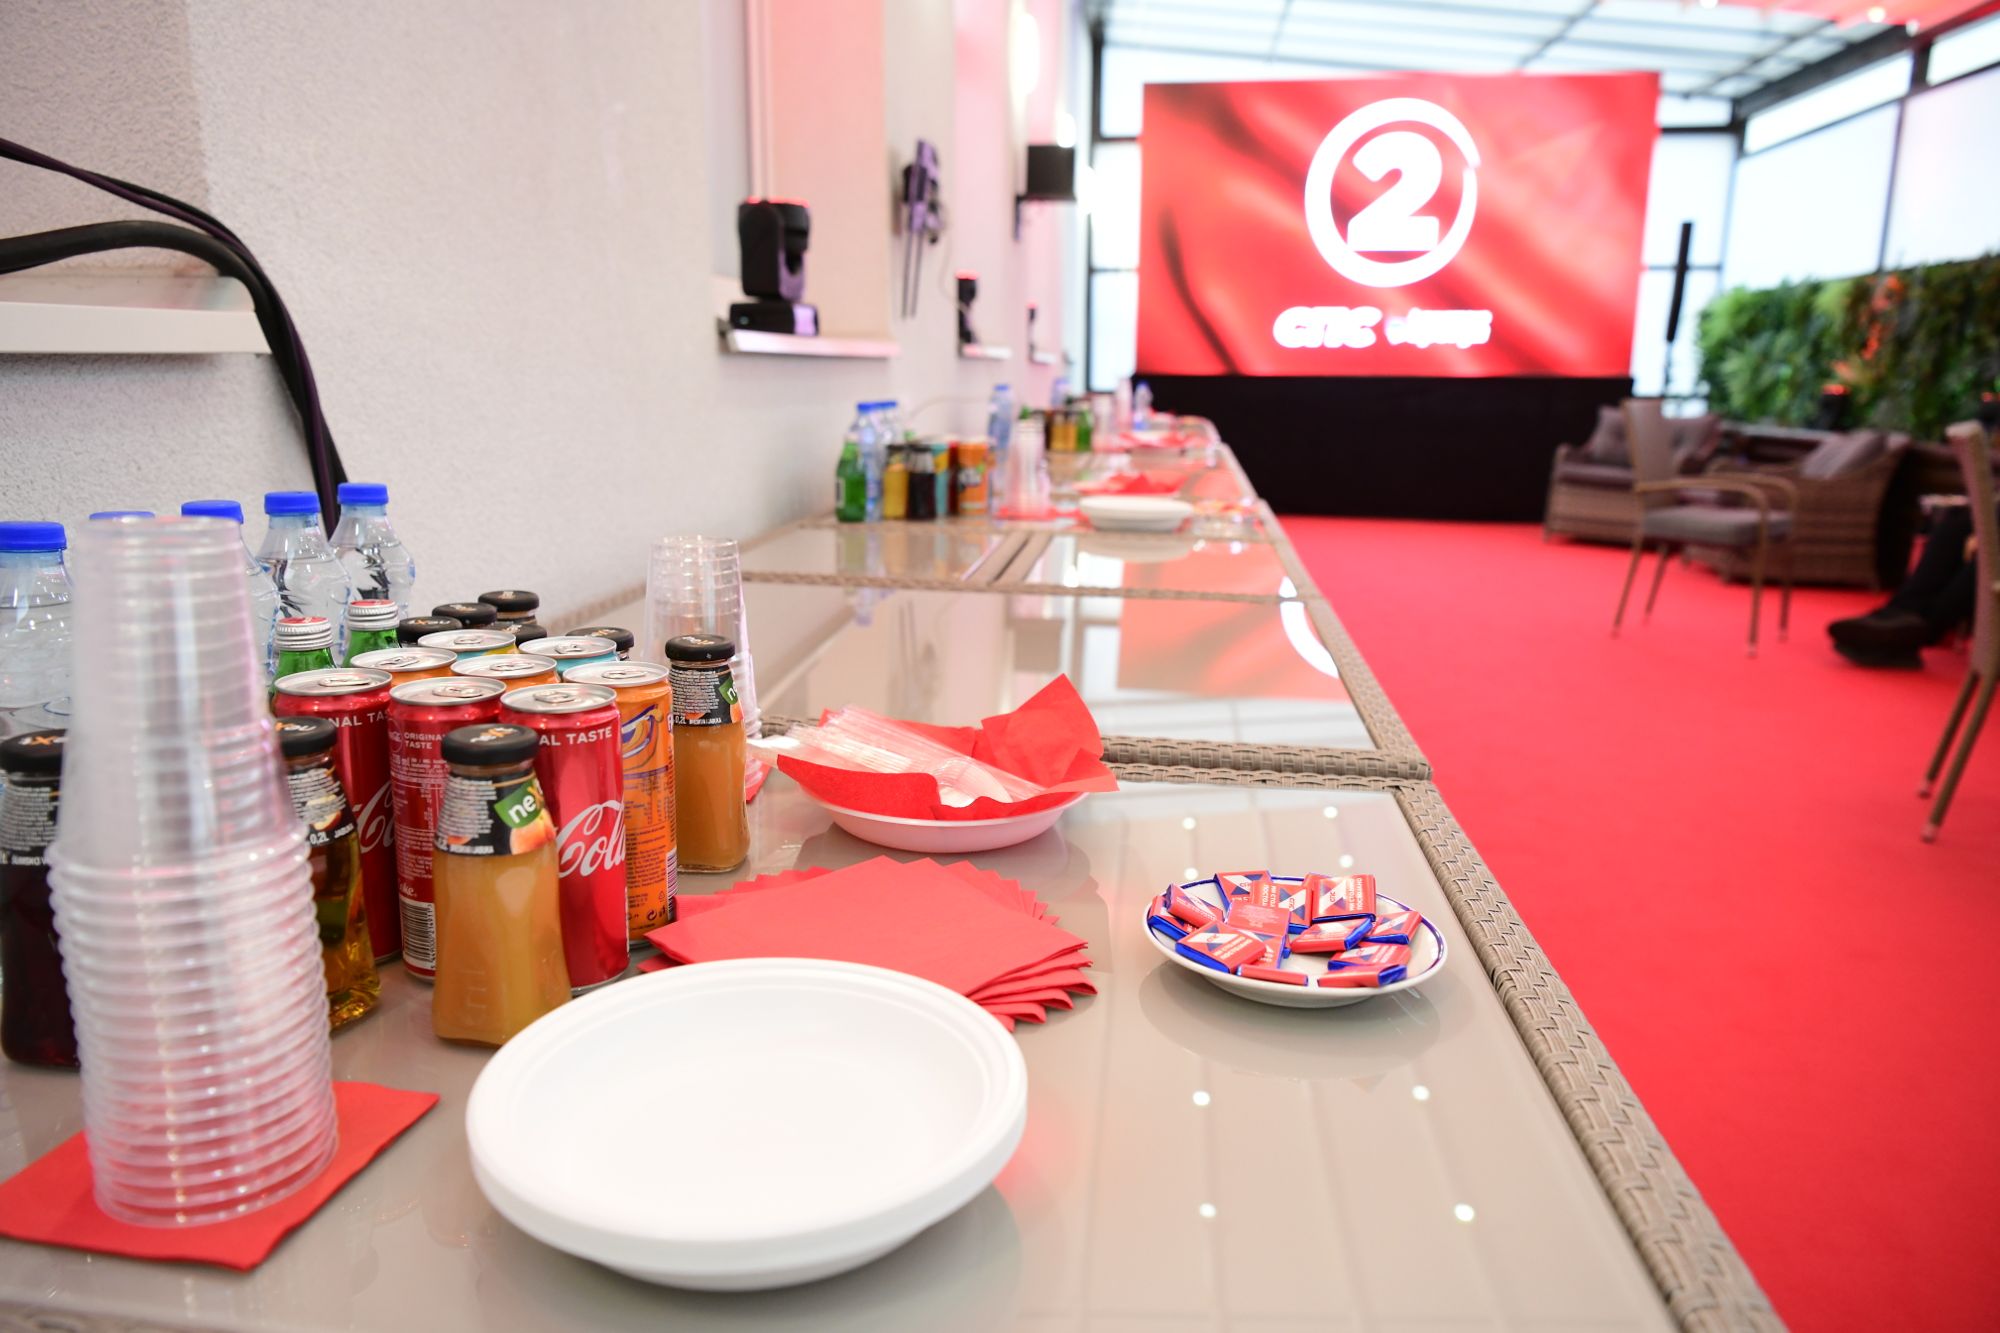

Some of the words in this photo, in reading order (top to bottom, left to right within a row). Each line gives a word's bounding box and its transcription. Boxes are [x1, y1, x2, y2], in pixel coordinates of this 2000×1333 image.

[1347, 130, 1443, 252] 2
[403, 732, 446, 741] ORIGINA
[566, 726, 613, 745] TASTE
[405, 740, 433, 750] TASTE
